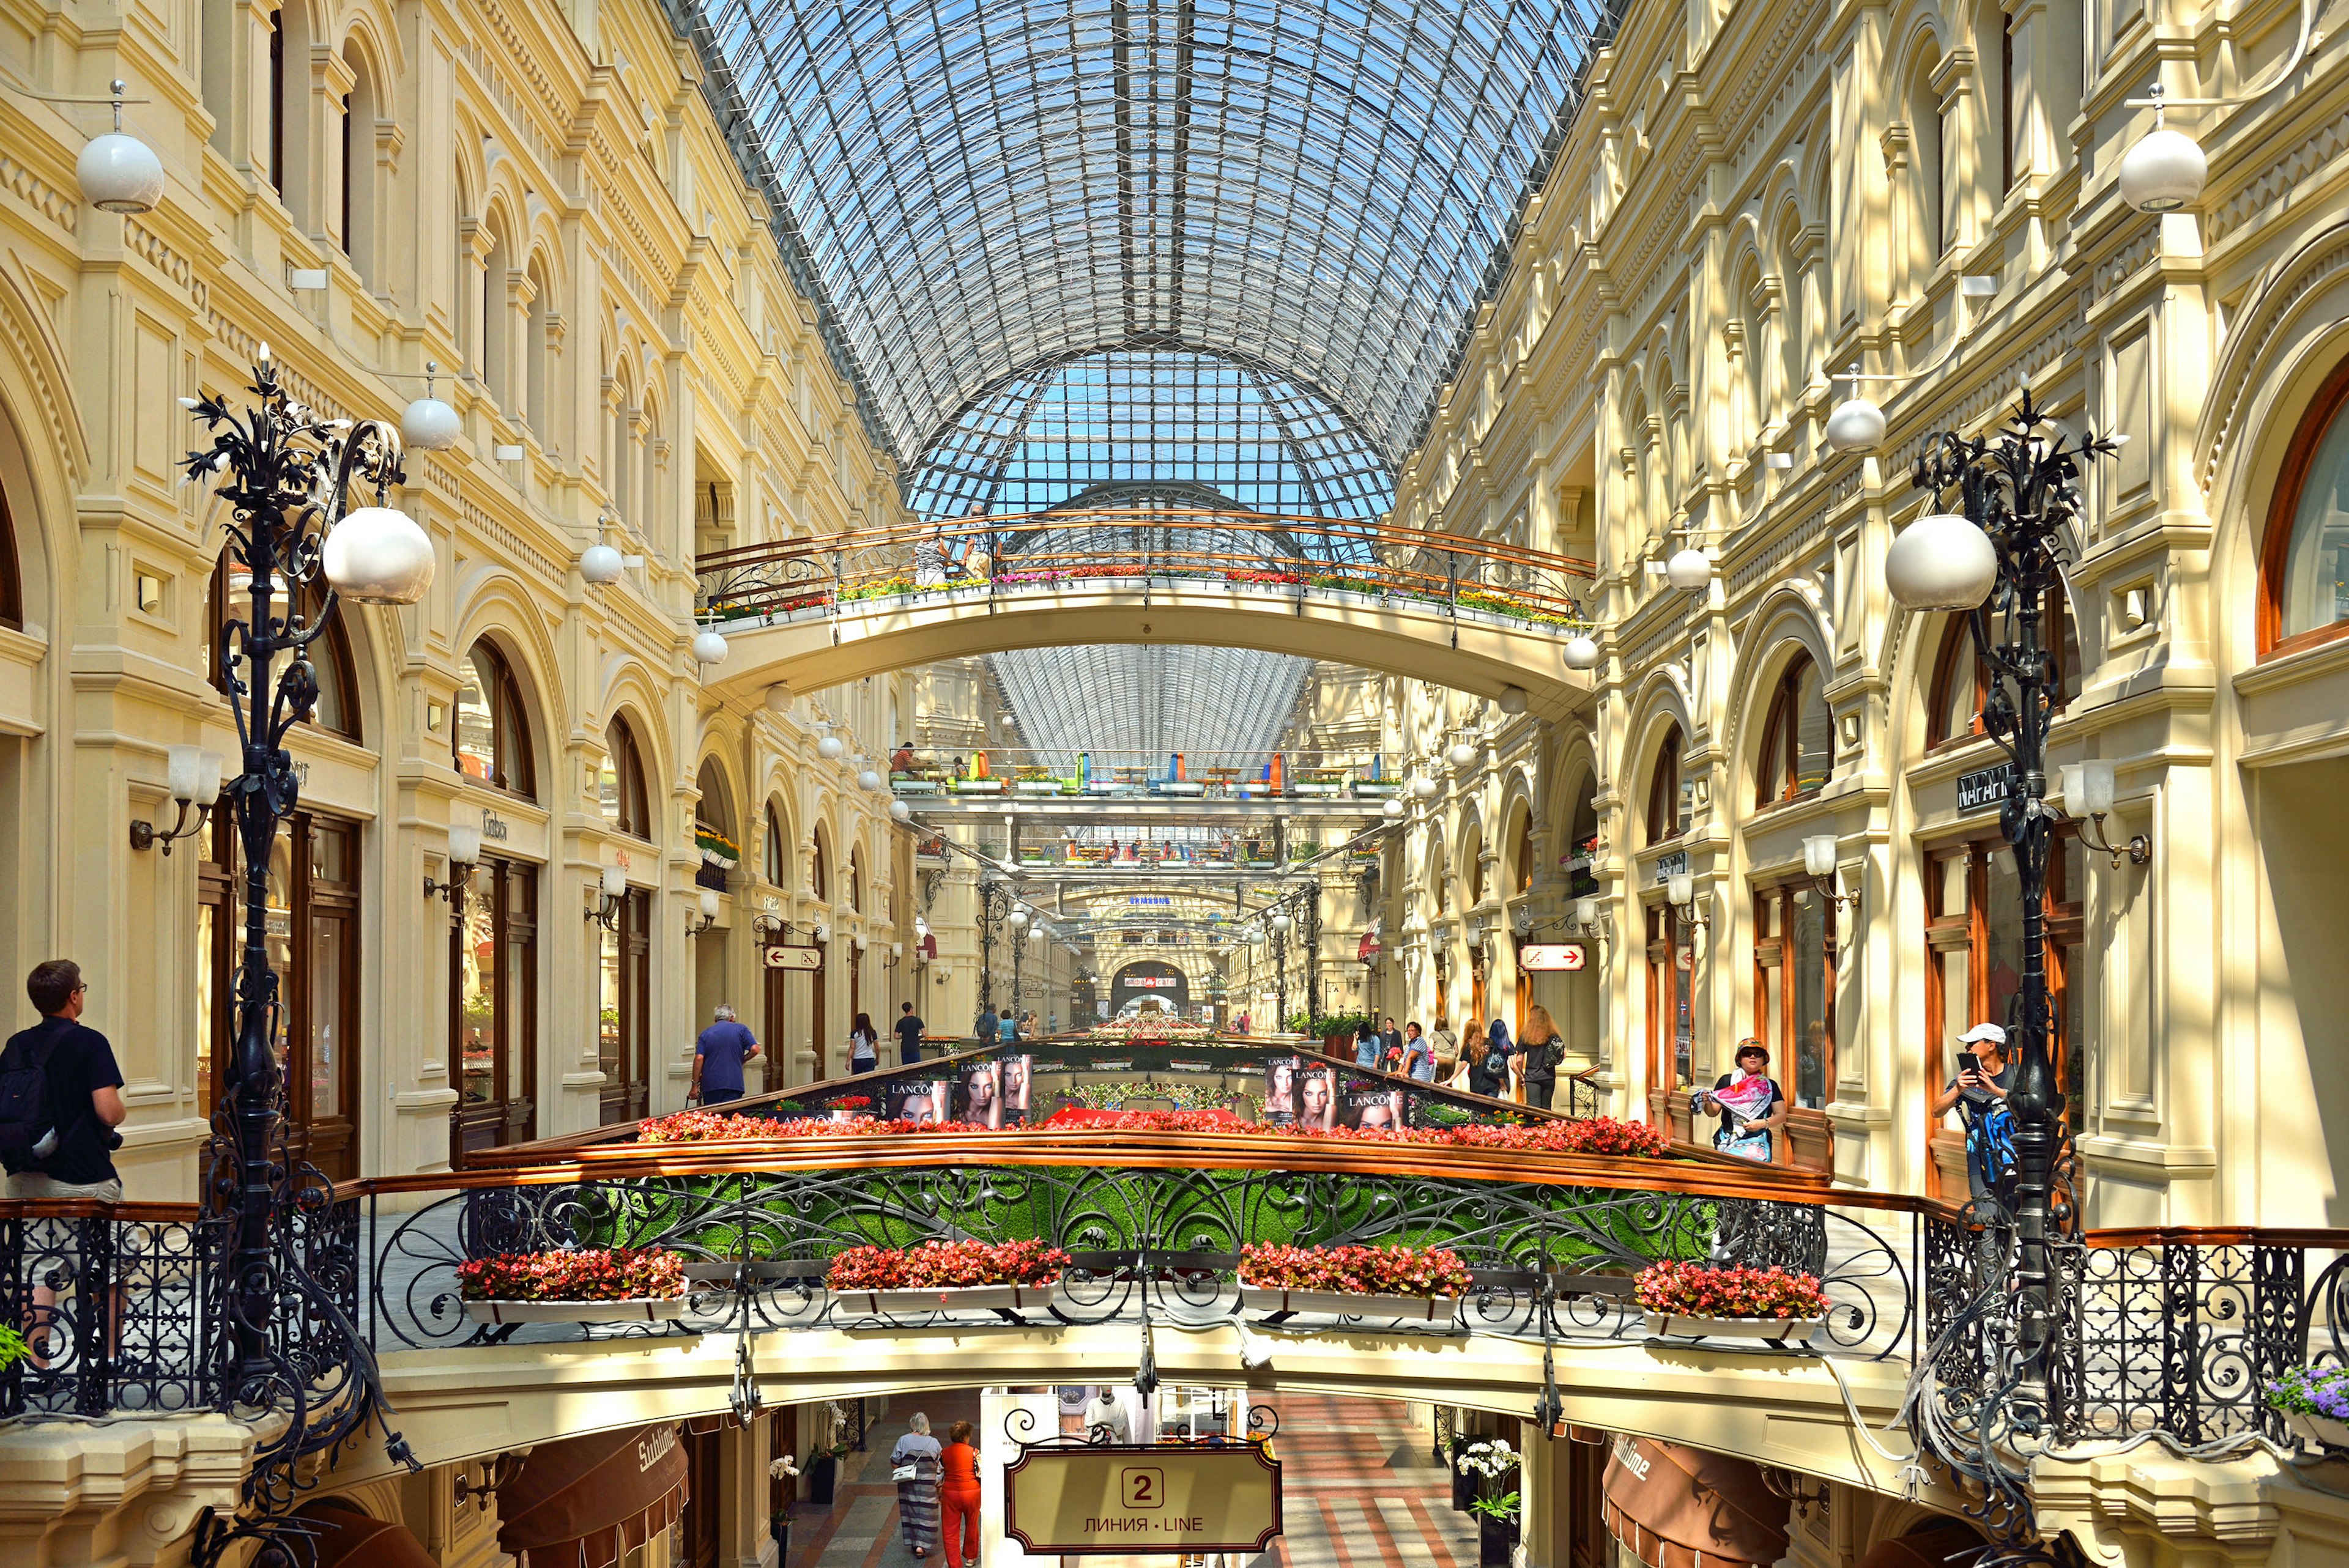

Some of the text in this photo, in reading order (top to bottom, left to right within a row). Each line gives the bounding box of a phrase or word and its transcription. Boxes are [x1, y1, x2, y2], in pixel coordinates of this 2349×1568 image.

[638, 1426, 676, 1473] Sublime
[1613, 1433, 1650, 1481] Sublime
[1134, 1475, 1152, 1500] 2
[1084, 1517, 1203, 1532] ЛИНИЯ LINE
